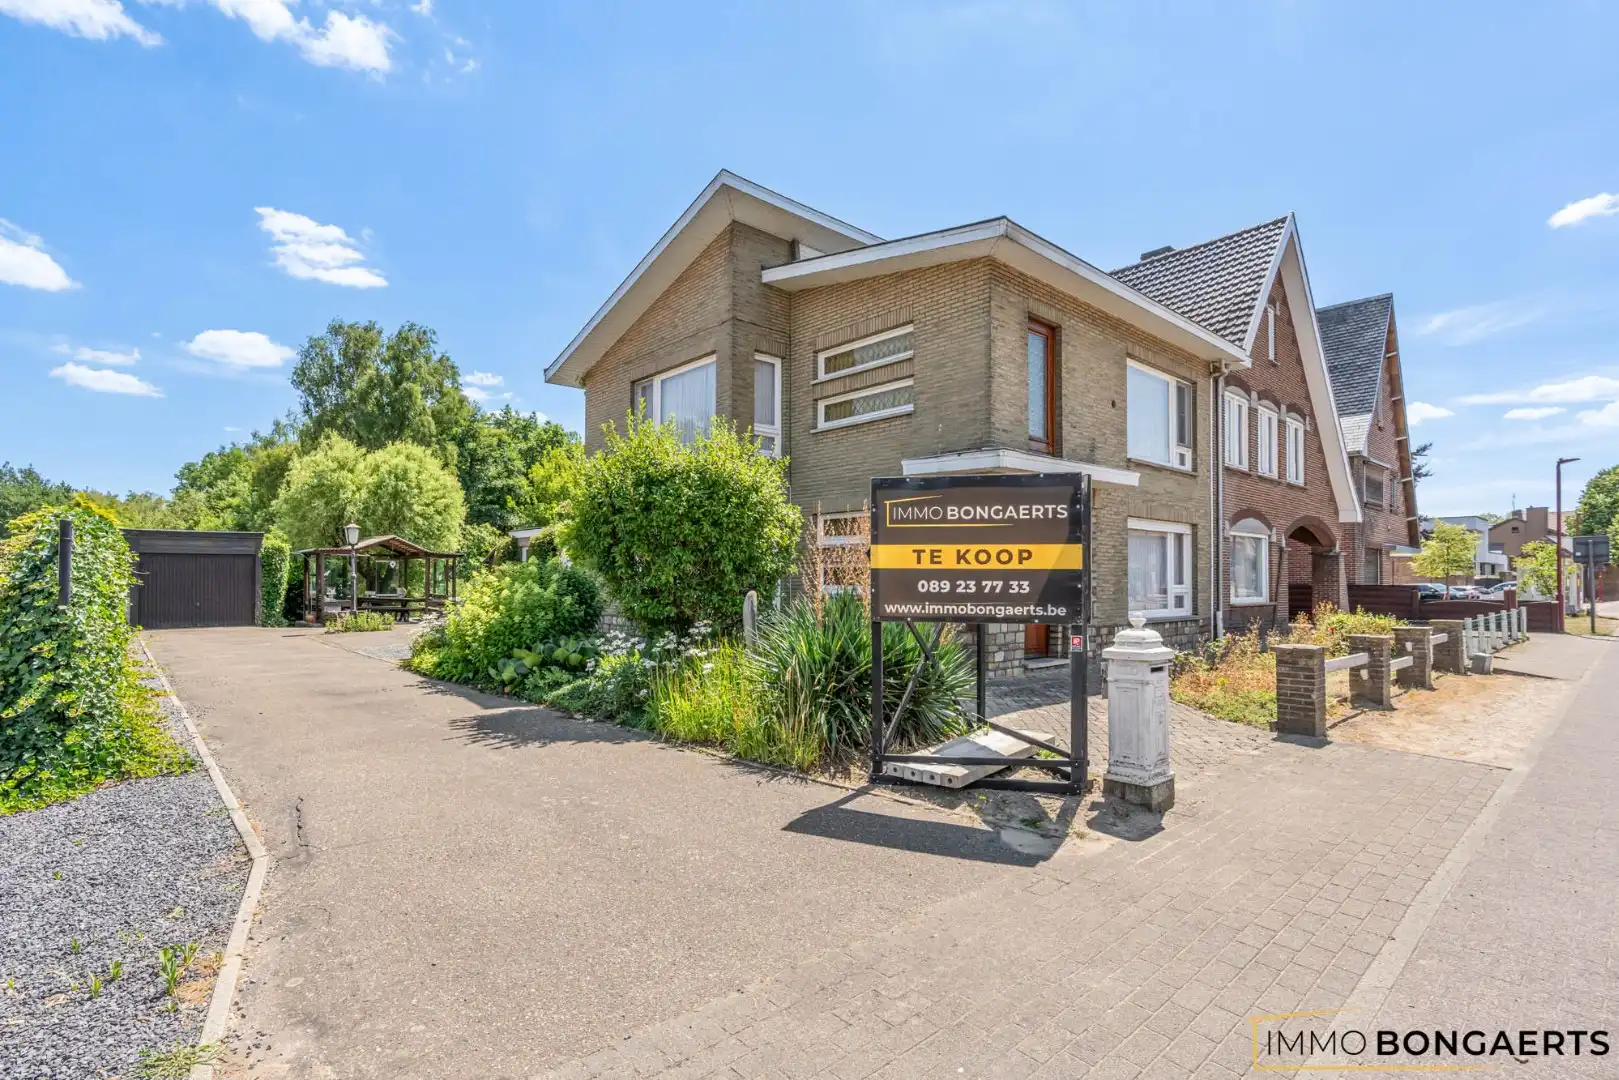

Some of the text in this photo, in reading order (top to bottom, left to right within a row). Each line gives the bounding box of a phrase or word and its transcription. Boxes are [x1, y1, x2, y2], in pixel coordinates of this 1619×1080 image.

[892, 504, 1068, 521] IMMO BONGAERTS
[912, 549, 1033, 565] TE KOOP
[917, 580, 1030, 594] 089 23 77 33
[884, 602, 1067, 616] www.immobongaerts.be
